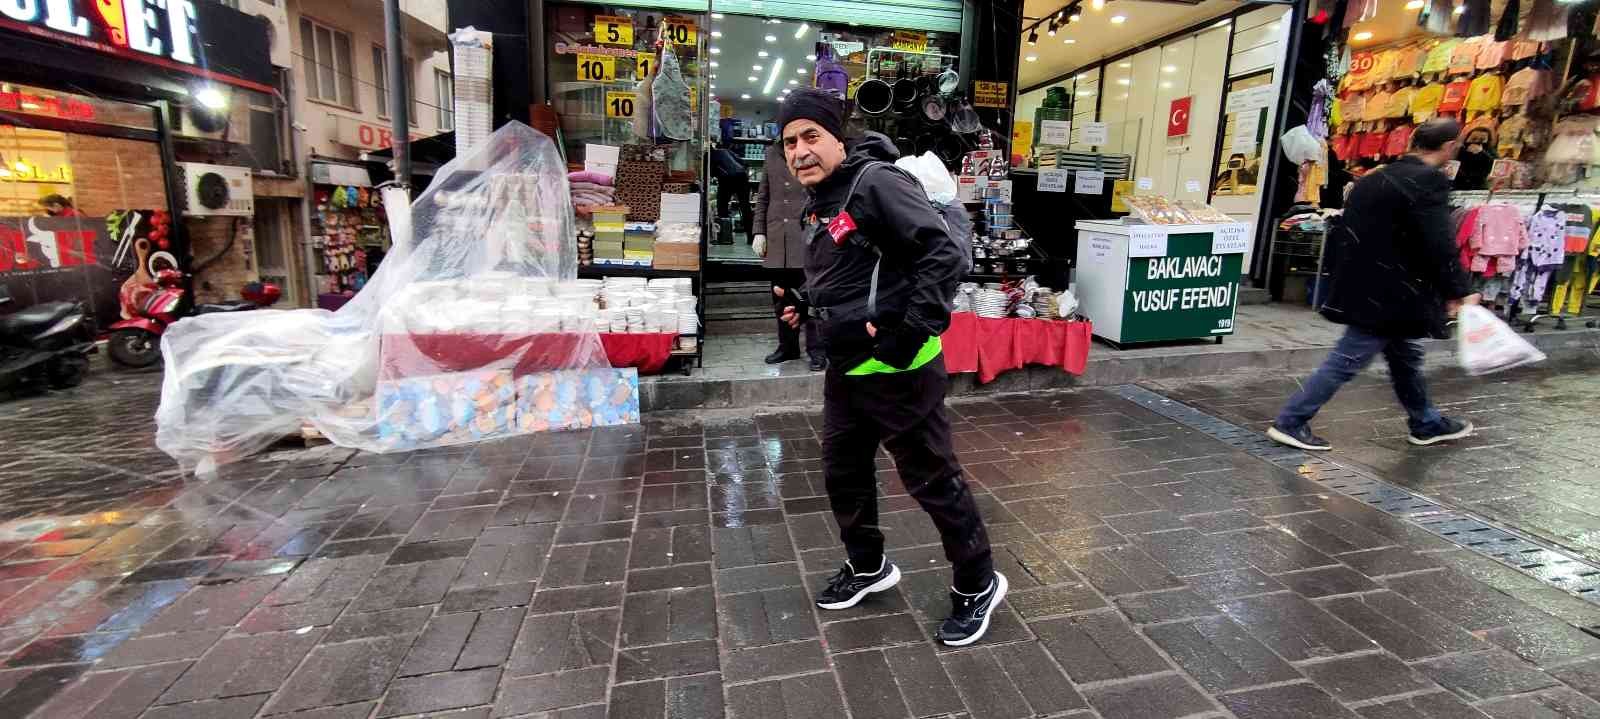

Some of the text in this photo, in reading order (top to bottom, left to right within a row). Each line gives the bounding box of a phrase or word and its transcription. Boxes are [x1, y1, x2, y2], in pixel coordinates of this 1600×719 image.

[608, 23, 620, 43] 5
[666, 24, 688, 43] 10
[581, 60, 604, 80] 10
[640, 60, 649, 78] 1
[1351, 56, 1373, 71] 30
[611, 97, 633, 117] 10
[1148, 256, 1222, 280] BAKLAVACI
[1133, 282, 1232, 312] YUSUF EFENDİ
